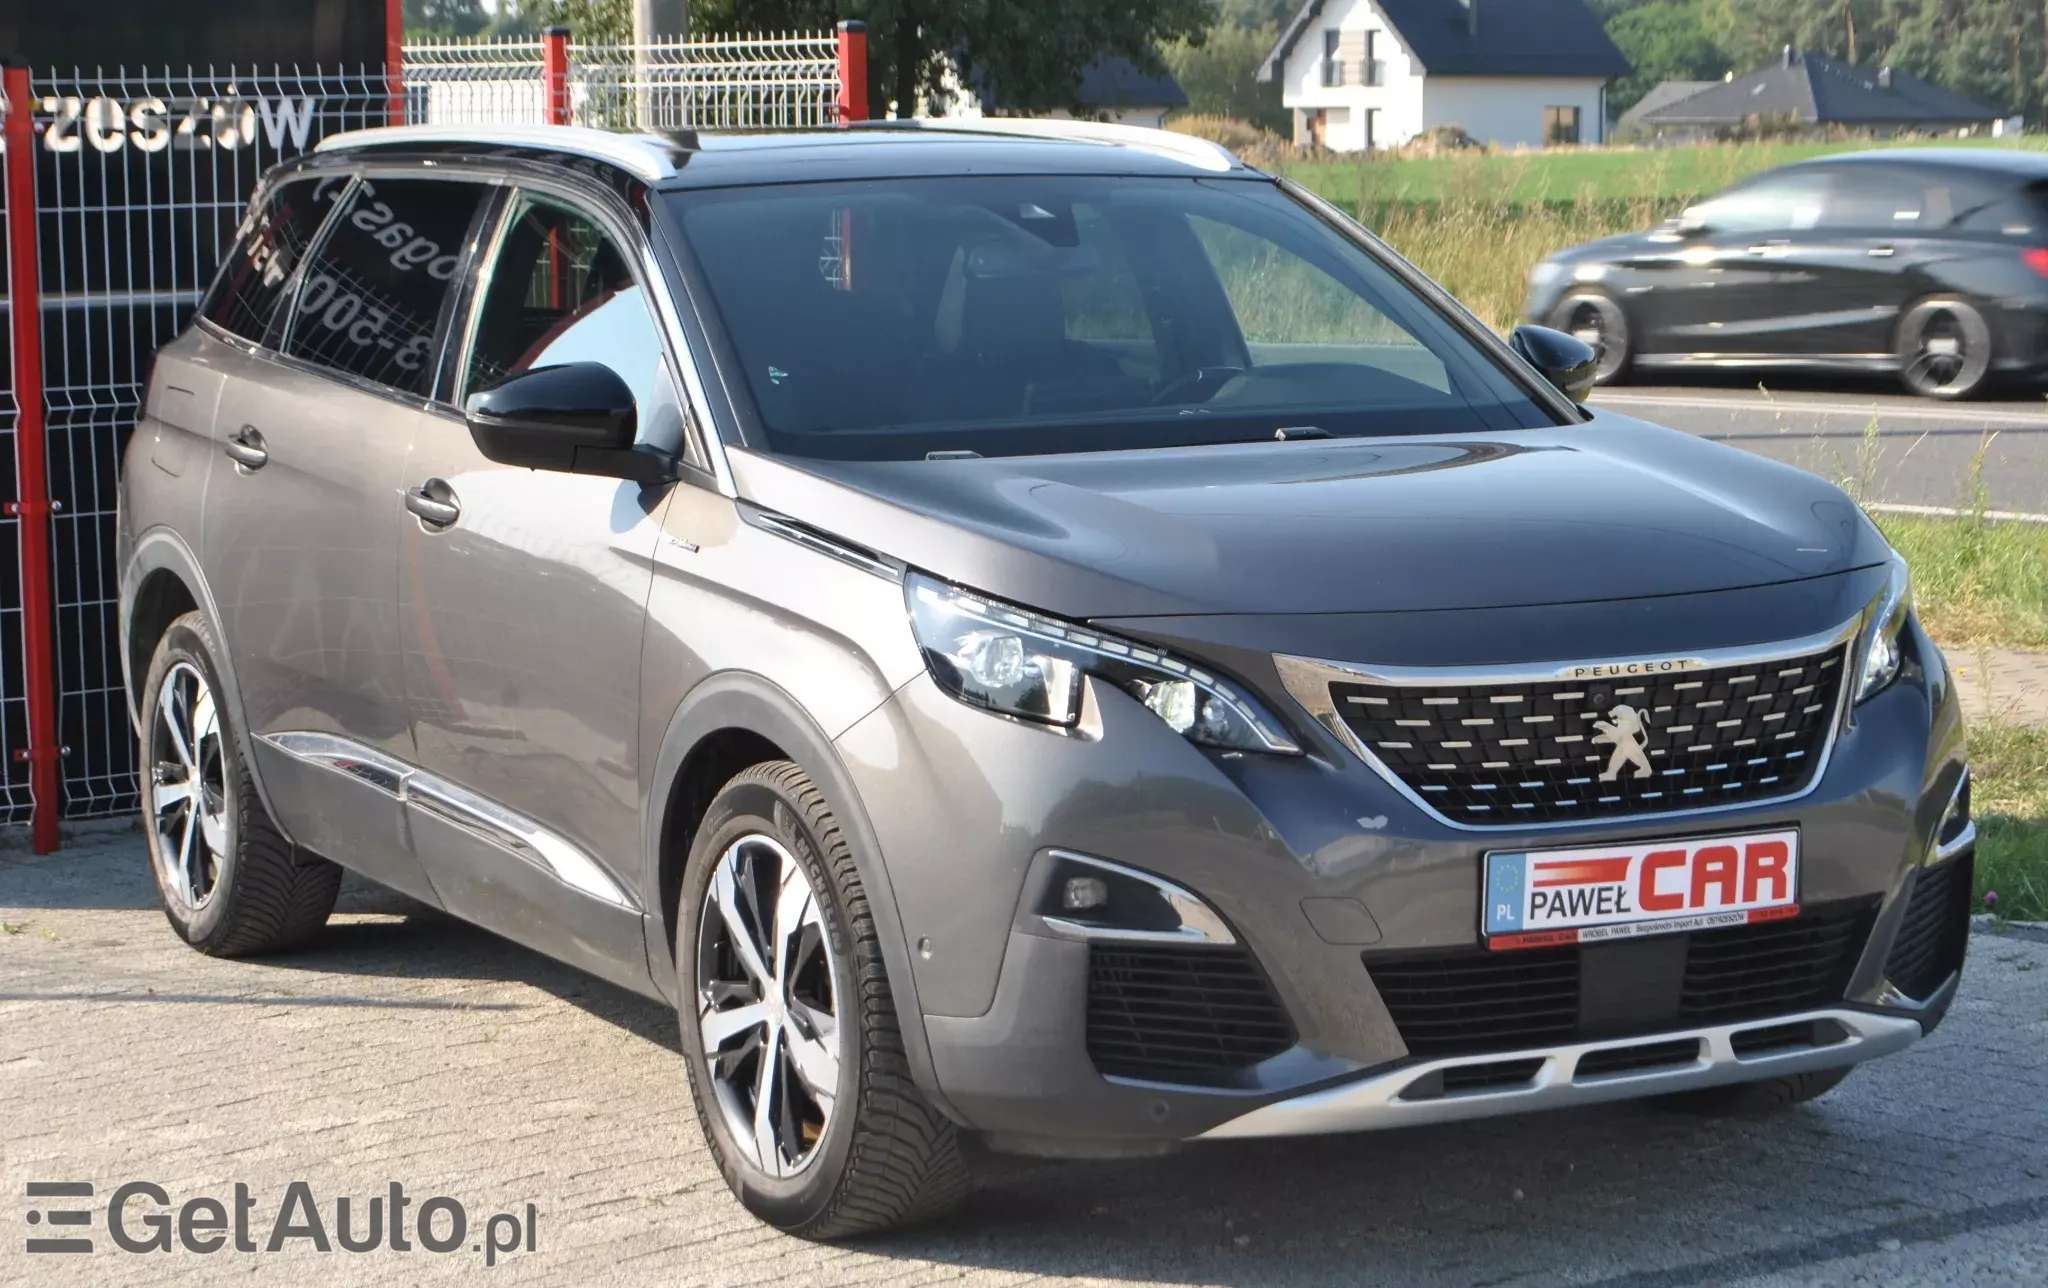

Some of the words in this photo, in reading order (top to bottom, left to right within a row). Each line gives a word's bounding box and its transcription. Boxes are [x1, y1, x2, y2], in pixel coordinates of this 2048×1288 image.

[1575, 660, 1688, 678] PEUGEOT
[797, 836, 843, 950] MICHELIN
[1638, 840, 1789, 912] CAR
[1496, 903, 1515, 921] PL
[1529, 885, 1632, 920] PAWEŁ
